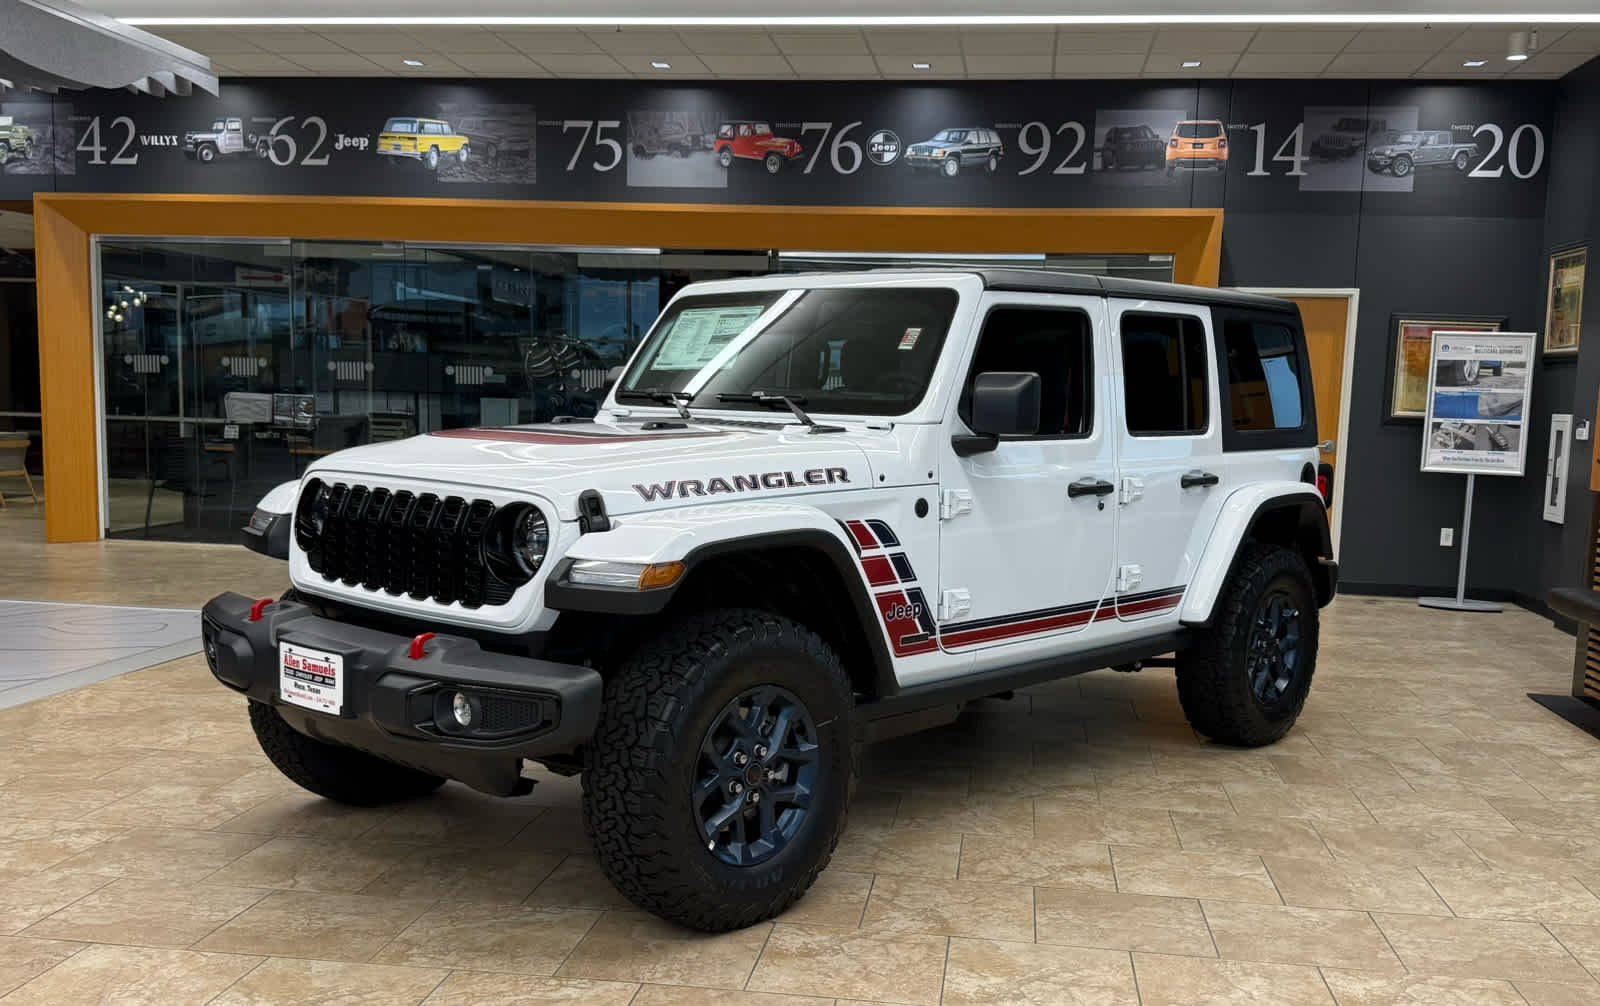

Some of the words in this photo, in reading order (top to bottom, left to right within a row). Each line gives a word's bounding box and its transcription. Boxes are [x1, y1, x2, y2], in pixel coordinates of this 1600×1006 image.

[76, 116, 138, 165] 42
[140, 135, 178, 147] WILLYS
[268, 116, 330, 166] 62
[334, 134, 369, 150] Jeep
[563, 120, 623, 171] 75
[801, 121, 862, 174] 76
[871, 143, 896, 152] Jeep
[1018, 121, 1087, 175] 92
[1247, 122, 1310, 176] 14
[1468, 123, 1544, 179] 20
[632, 467, 850, 502] WRANGLER
[886, 602, 922, 621] Jeep
[284, 654, 300, 668] Allen
[302, 659, 336, 676] Samuels
